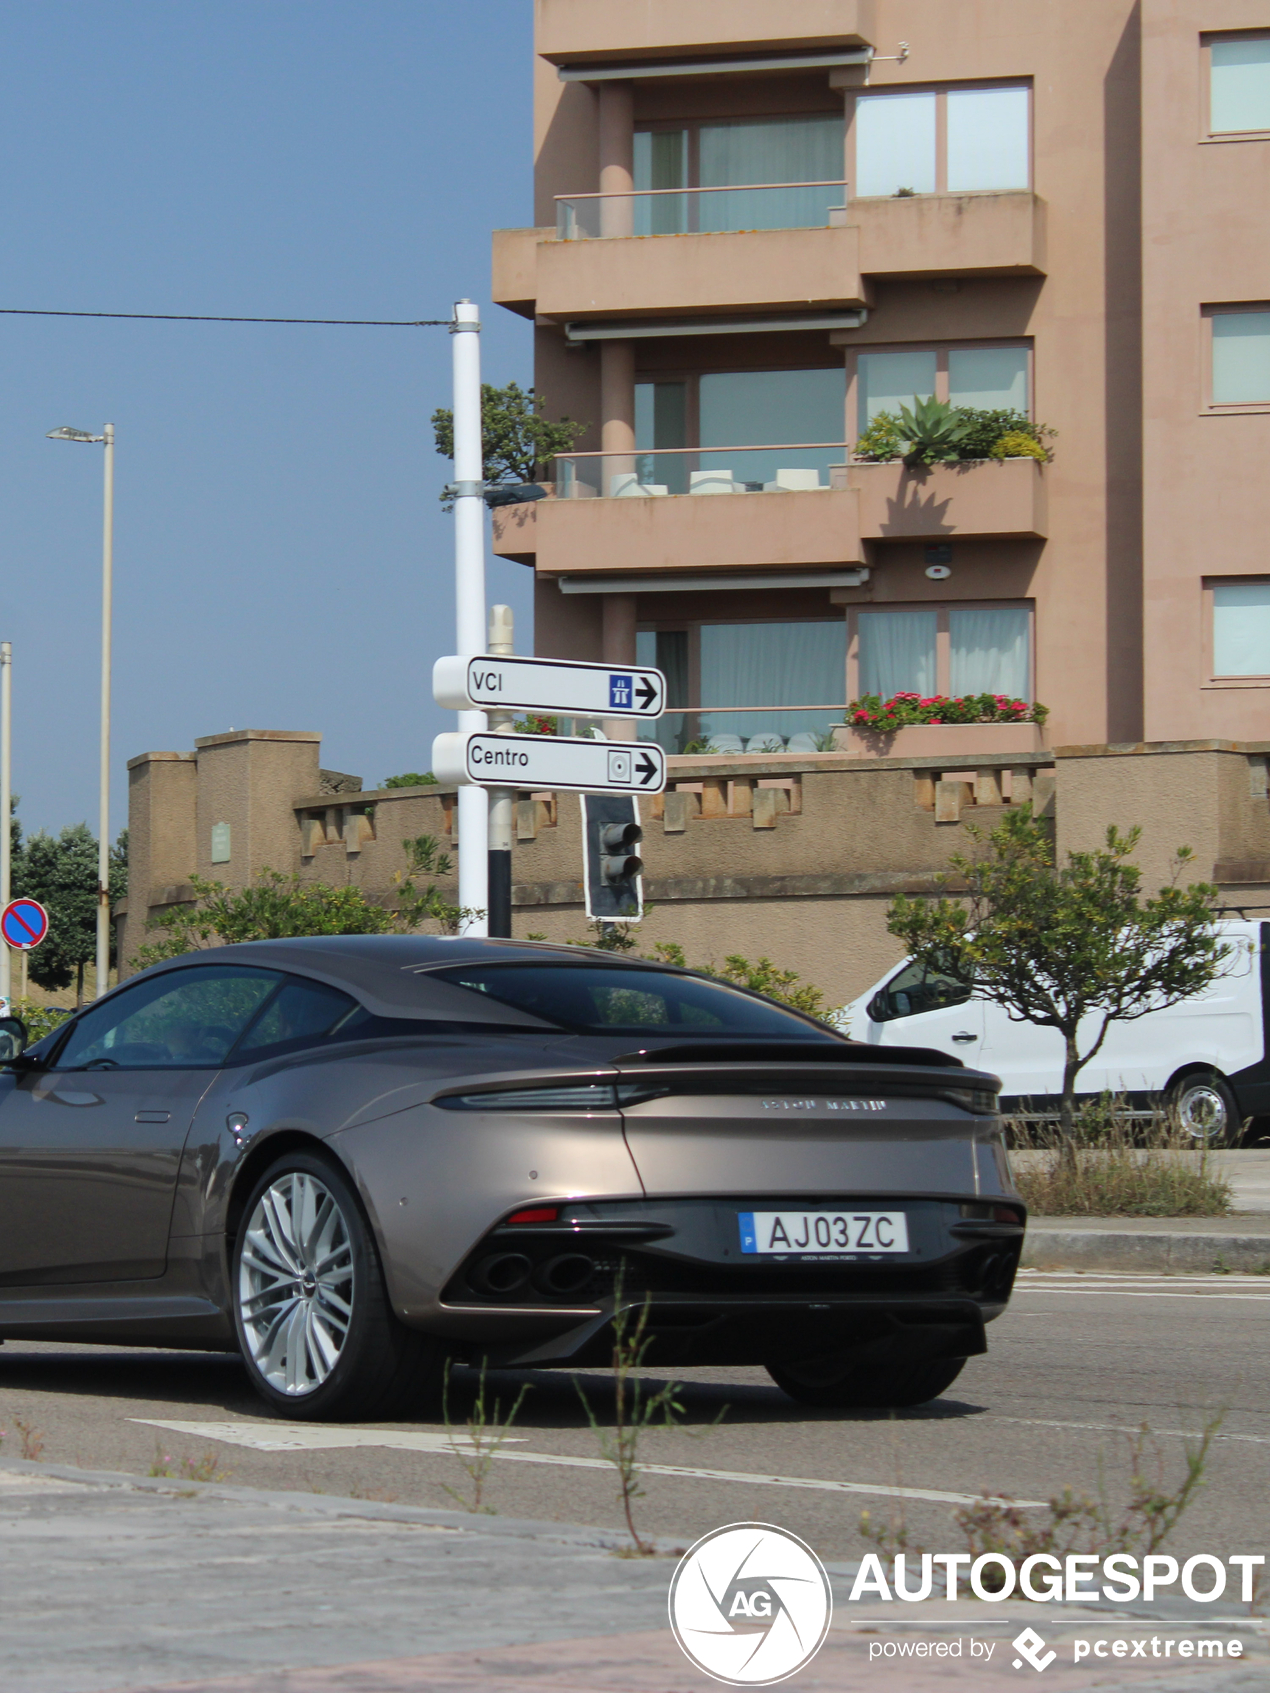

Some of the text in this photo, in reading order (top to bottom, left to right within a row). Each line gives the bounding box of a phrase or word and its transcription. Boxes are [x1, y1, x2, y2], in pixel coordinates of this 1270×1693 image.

[472, 671, 503, 692] VCI
[470, 745, 529, 768] Centro
[761, 1100, 888, 1111] ASTON MARTIN
[745, 1237, 753, 1246] P
[768, 1216, 895, 1249] AJ03ZC
